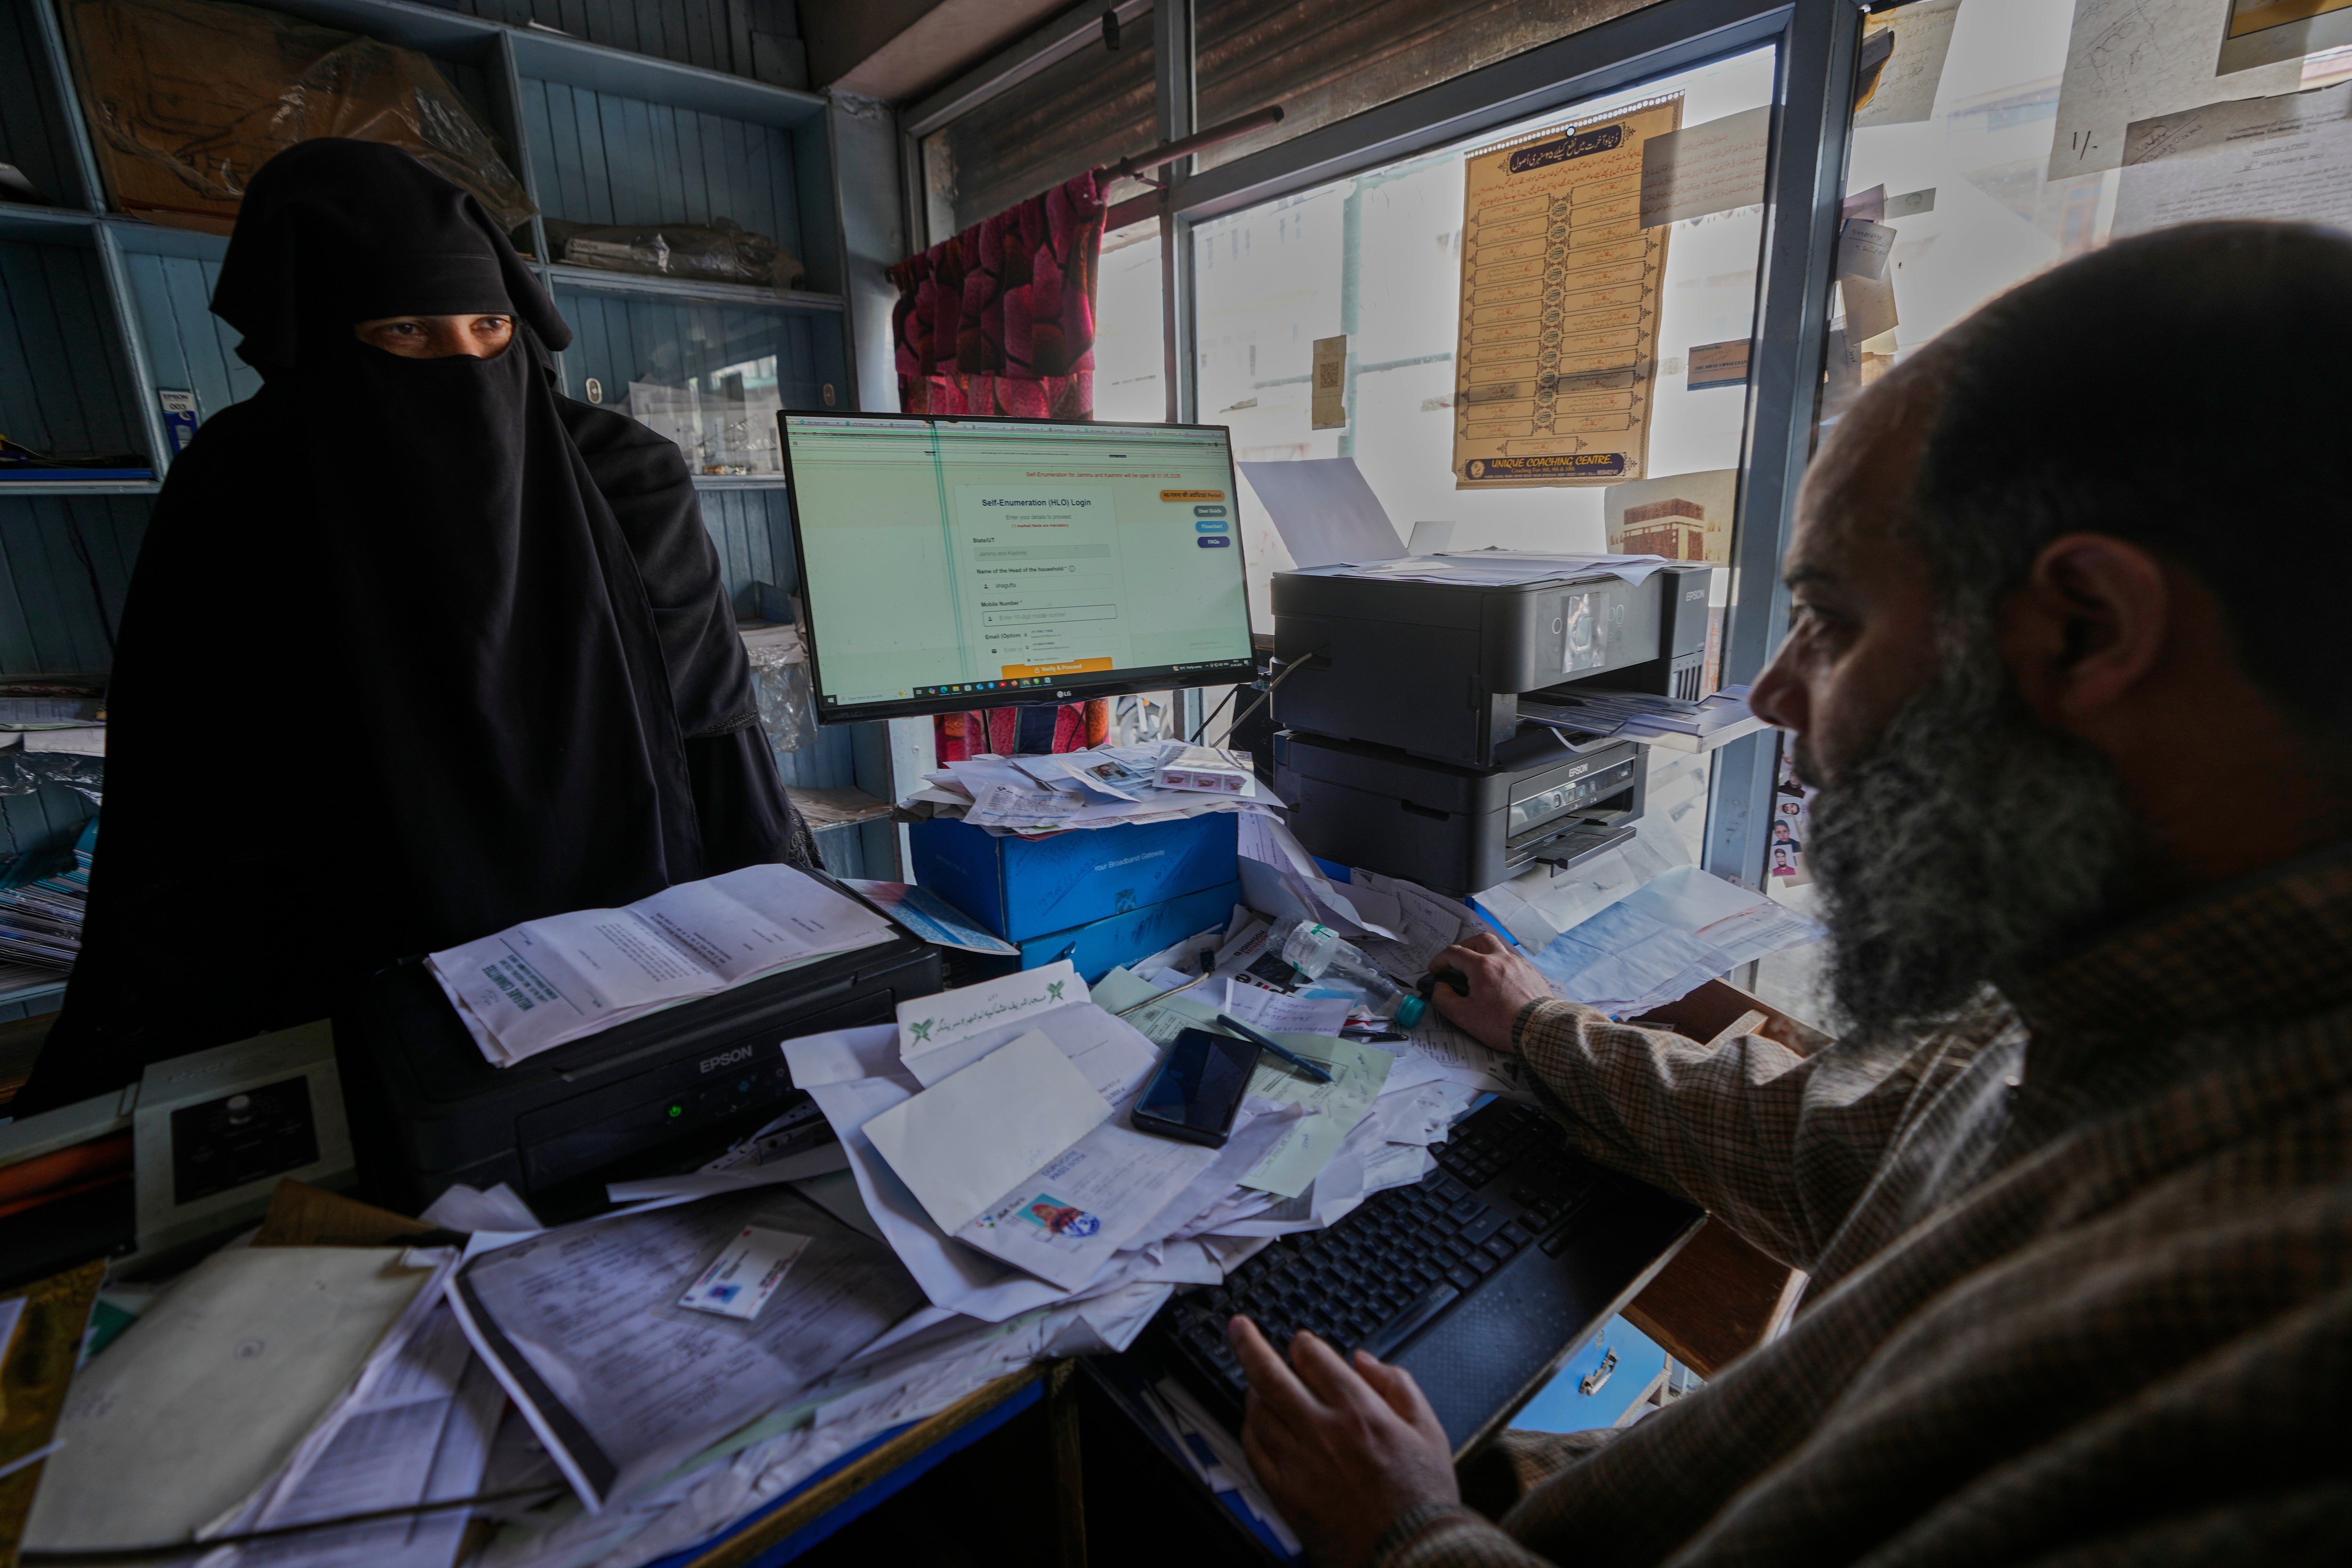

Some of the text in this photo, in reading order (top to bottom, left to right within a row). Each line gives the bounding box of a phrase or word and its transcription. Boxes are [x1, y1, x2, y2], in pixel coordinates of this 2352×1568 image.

[2253, 142, 2309, 155] NOTIFICATION
[1492, 458, 1525, 469] UNIQUE
[1526, 456, 1573, 467] COACHING
[1685, 589, 1705, 602] EPSON
[1568, 763, 1589, 777] EPSON
[1108, 856, 1140, 868] Broadband
[1141, 849, 1166, 860] Gateway
[1239, 931, 1266, 953] JOHNSON
[699, 1044, 752, 1074] EPSON
